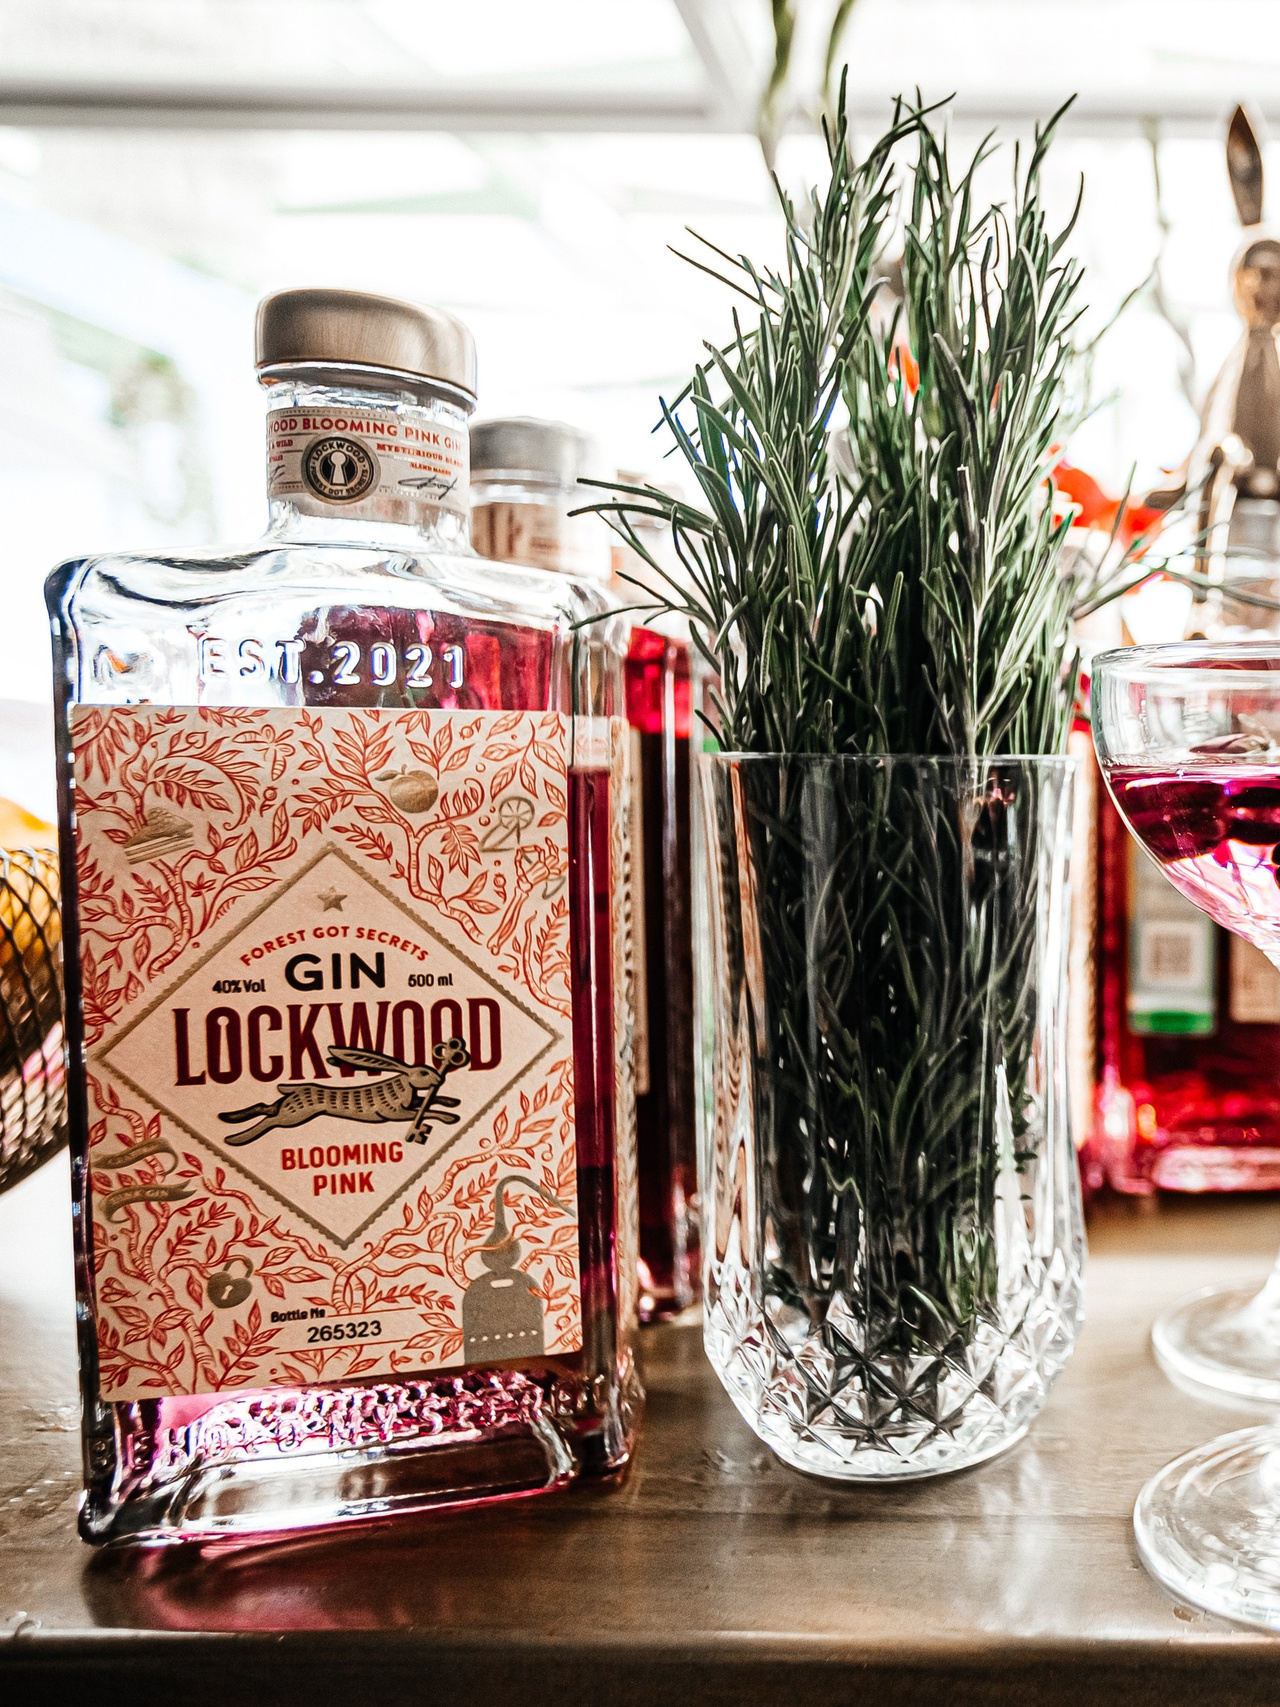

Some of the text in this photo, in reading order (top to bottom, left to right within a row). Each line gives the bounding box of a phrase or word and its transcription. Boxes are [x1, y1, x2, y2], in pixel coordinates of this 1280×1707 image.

[303, 417, 398, 437] BLOOMING
[404, 426, 440, 446] PINK
[312, 441, 366, 464] LOCKWOOD
[239, 926, 429, 967] FOREST GOT SECRETS
[284, 952, 386, 992] GIN
[437, 972, 454, 987] ml
[172, 997, 502, 1087] LOCKWOOD
[281, 1141, 404, 1171] BLOOMING
[313, 1171, 375, 1197] PINK
[270, 1308, 309, 1324] Bottle
[307, 1320, 382, 1343] 265323
